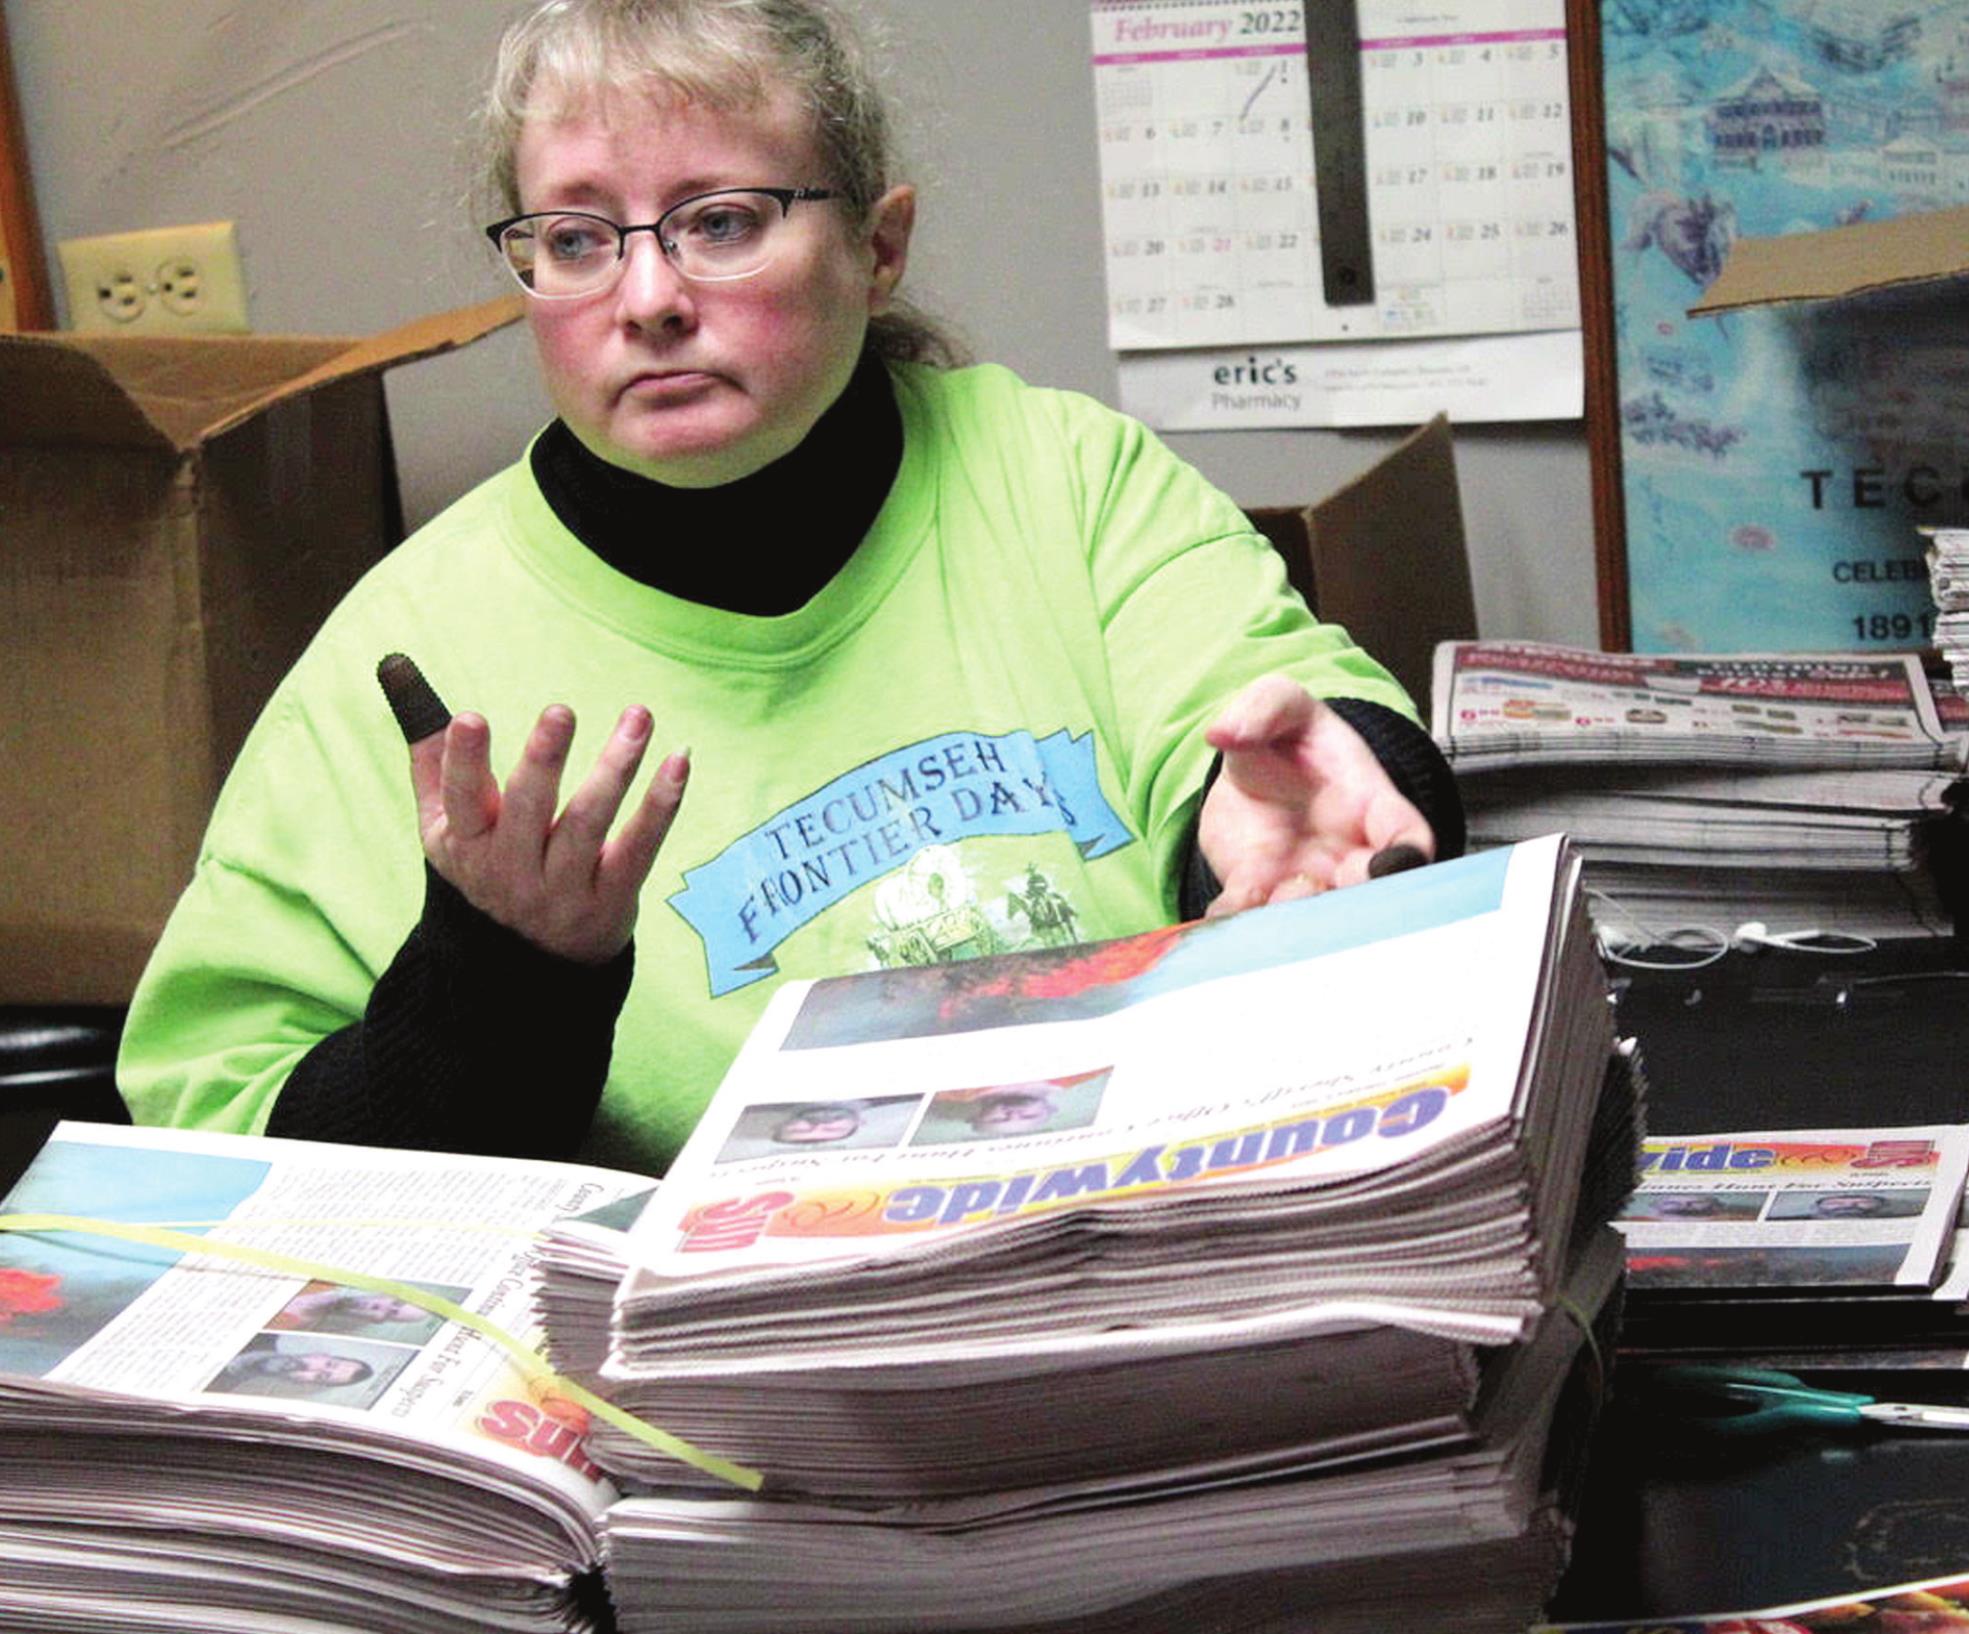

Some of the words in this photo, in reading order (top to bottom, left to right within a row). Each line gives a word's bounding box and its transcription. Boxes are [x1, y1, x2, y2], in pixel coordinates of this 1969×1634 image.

[1115, 17, 1232, 43] February
[1239, 10, 1301, 35] 2022
[1480, 48, 1491, 62] 4
[1212, 120, 1223, 135] 7
[1406, 110, 1427, 127] 10
[1476, 106, 1495, 122] 11
[1542, 102, 1563, 119] 12
[1142, 181, 1160, 198] 13
[1208, 180, 1226, 195] 14
[1274, 176, 1293, 192] 15
[1408, 167, 1428, 184] 17
[1479, 165, 1497, 180] 18
[1547, 162, 1566, 178] 19
[1145, 240, 1165, 256] 20
[1213, 237, 1232, 253] 21
[1278, 233, 1299, 249] 22
[1411, 227, 1432, 242] 24
[1480, 222, 1500, 239] 25
[1548, 221, 1569, 237] 26
[1147, 296, 1167, 313] 27
[1215, 294, 1235, 309] 28
[1213, 356, 1298, 386] eric's
[1211, 392, 1301, 412] Pharmacy
[1852, 613, 1932, 641] 1891
[766, 740, 1008, 861] TECUMSEH
[883, 1086, 1449, 1225] Countywide
